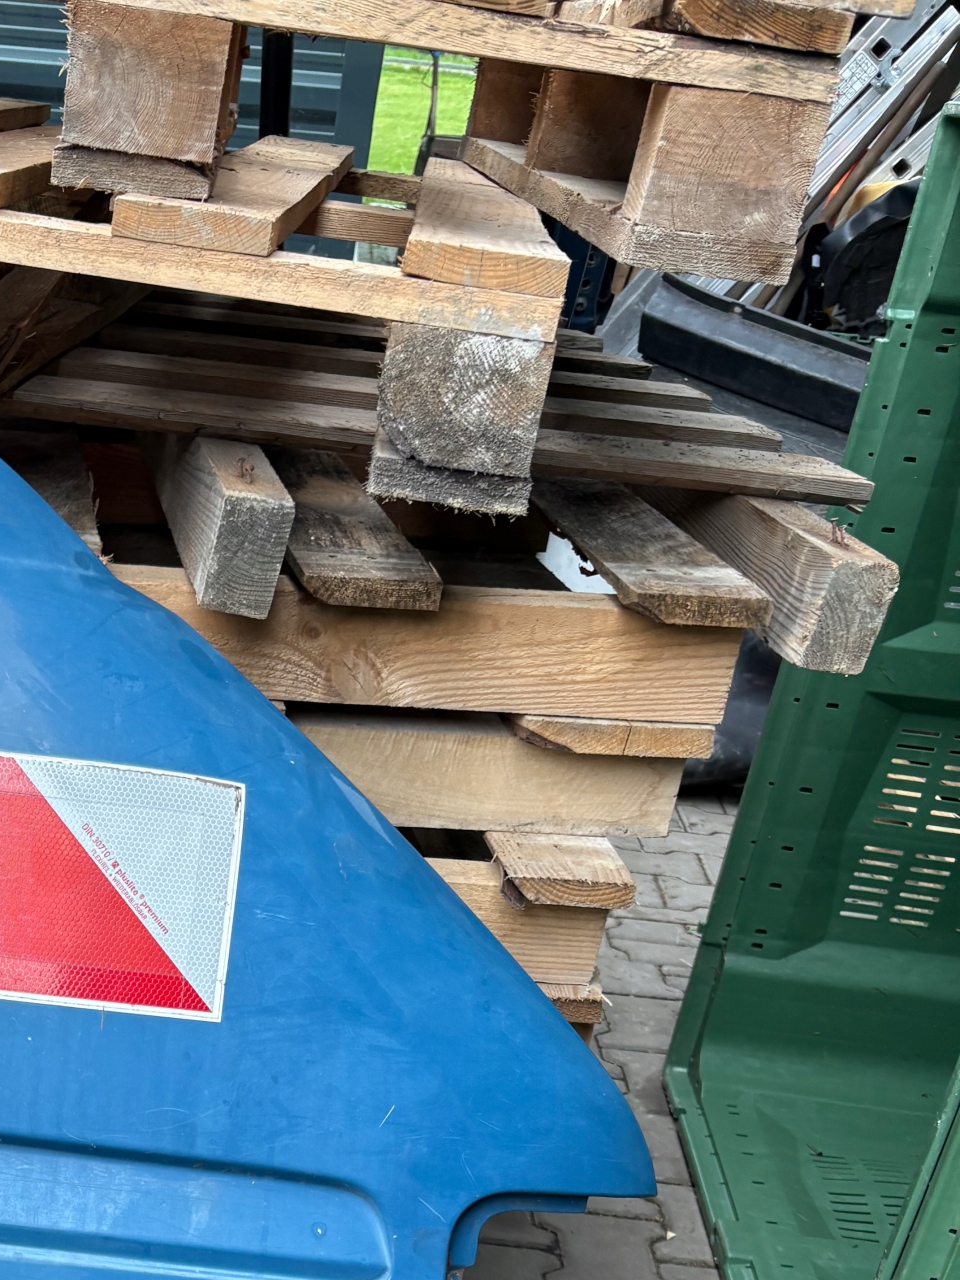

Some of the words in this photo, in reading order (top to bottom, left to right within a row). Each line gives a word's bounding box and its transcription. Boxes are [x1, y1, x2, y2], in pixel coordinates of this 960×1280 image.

[82, 823, 95, 838] DIN
[92, 837, 111, 858] 30710
[115, 869, 138, 896] pluslite
[140, 901, 168, 934] premium
